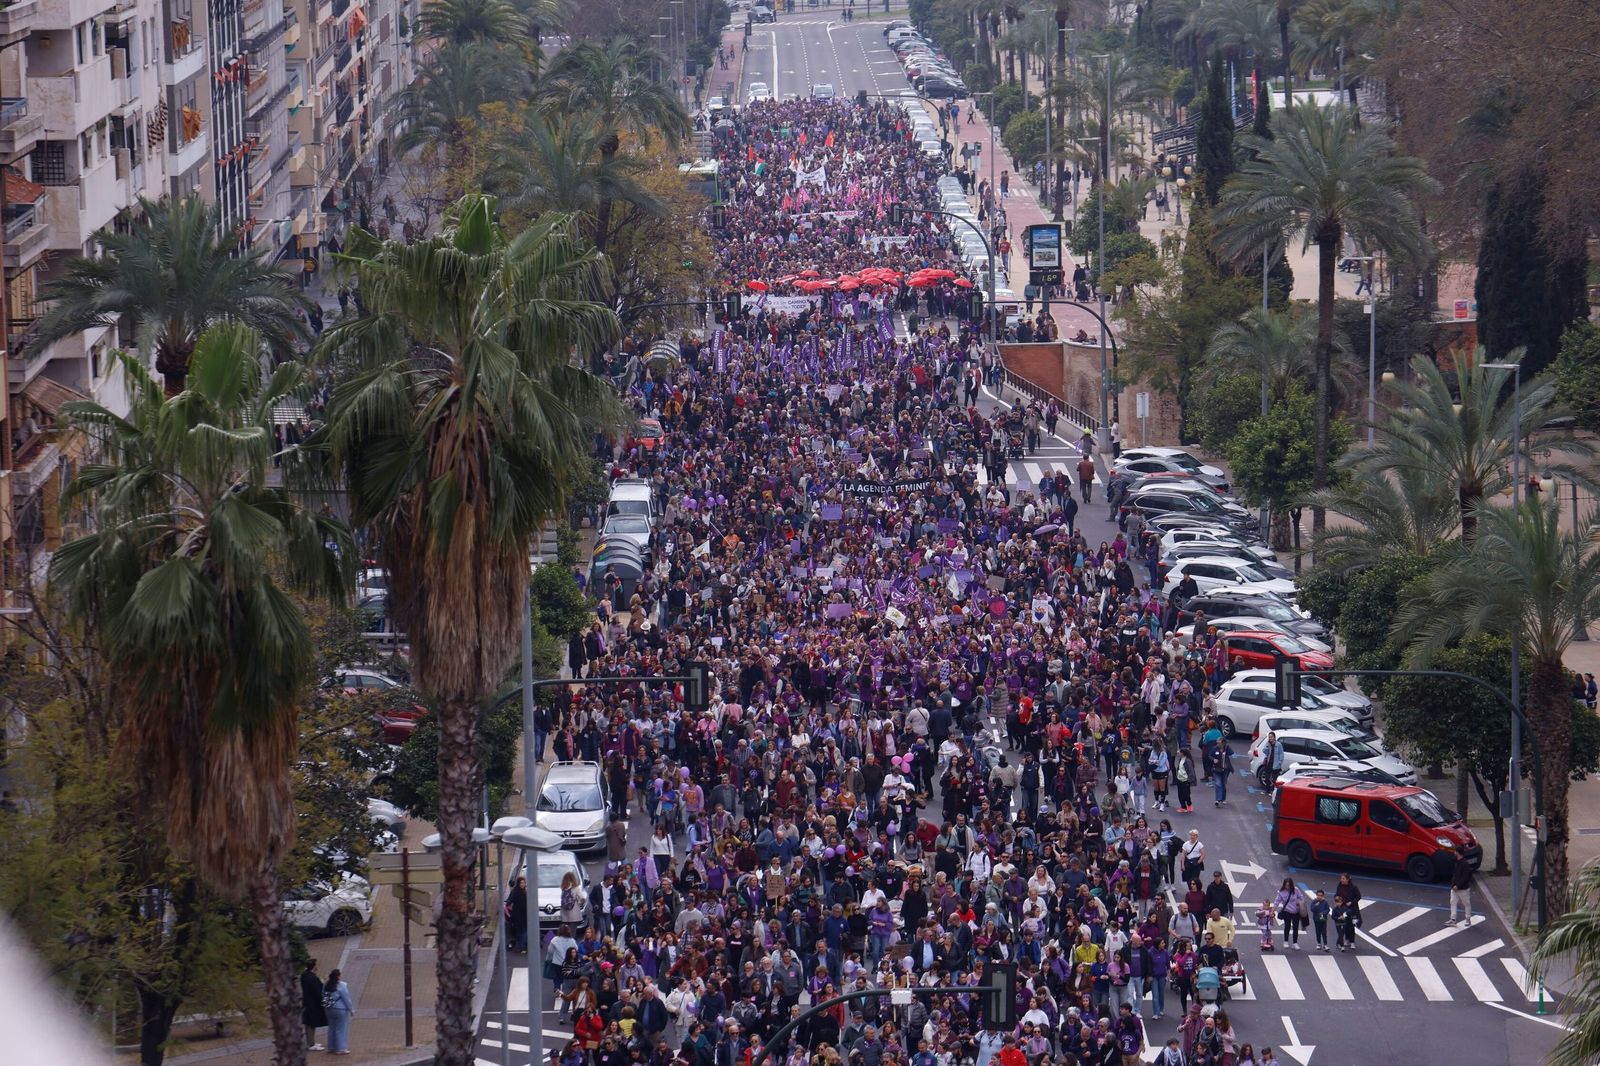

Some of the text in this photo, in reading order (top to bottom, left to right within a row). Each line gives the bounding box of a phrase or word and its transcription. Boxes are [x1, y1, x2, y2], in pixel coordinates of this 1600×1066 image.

[844, 481, 941, 494] LA AGENDA FEMINISA
